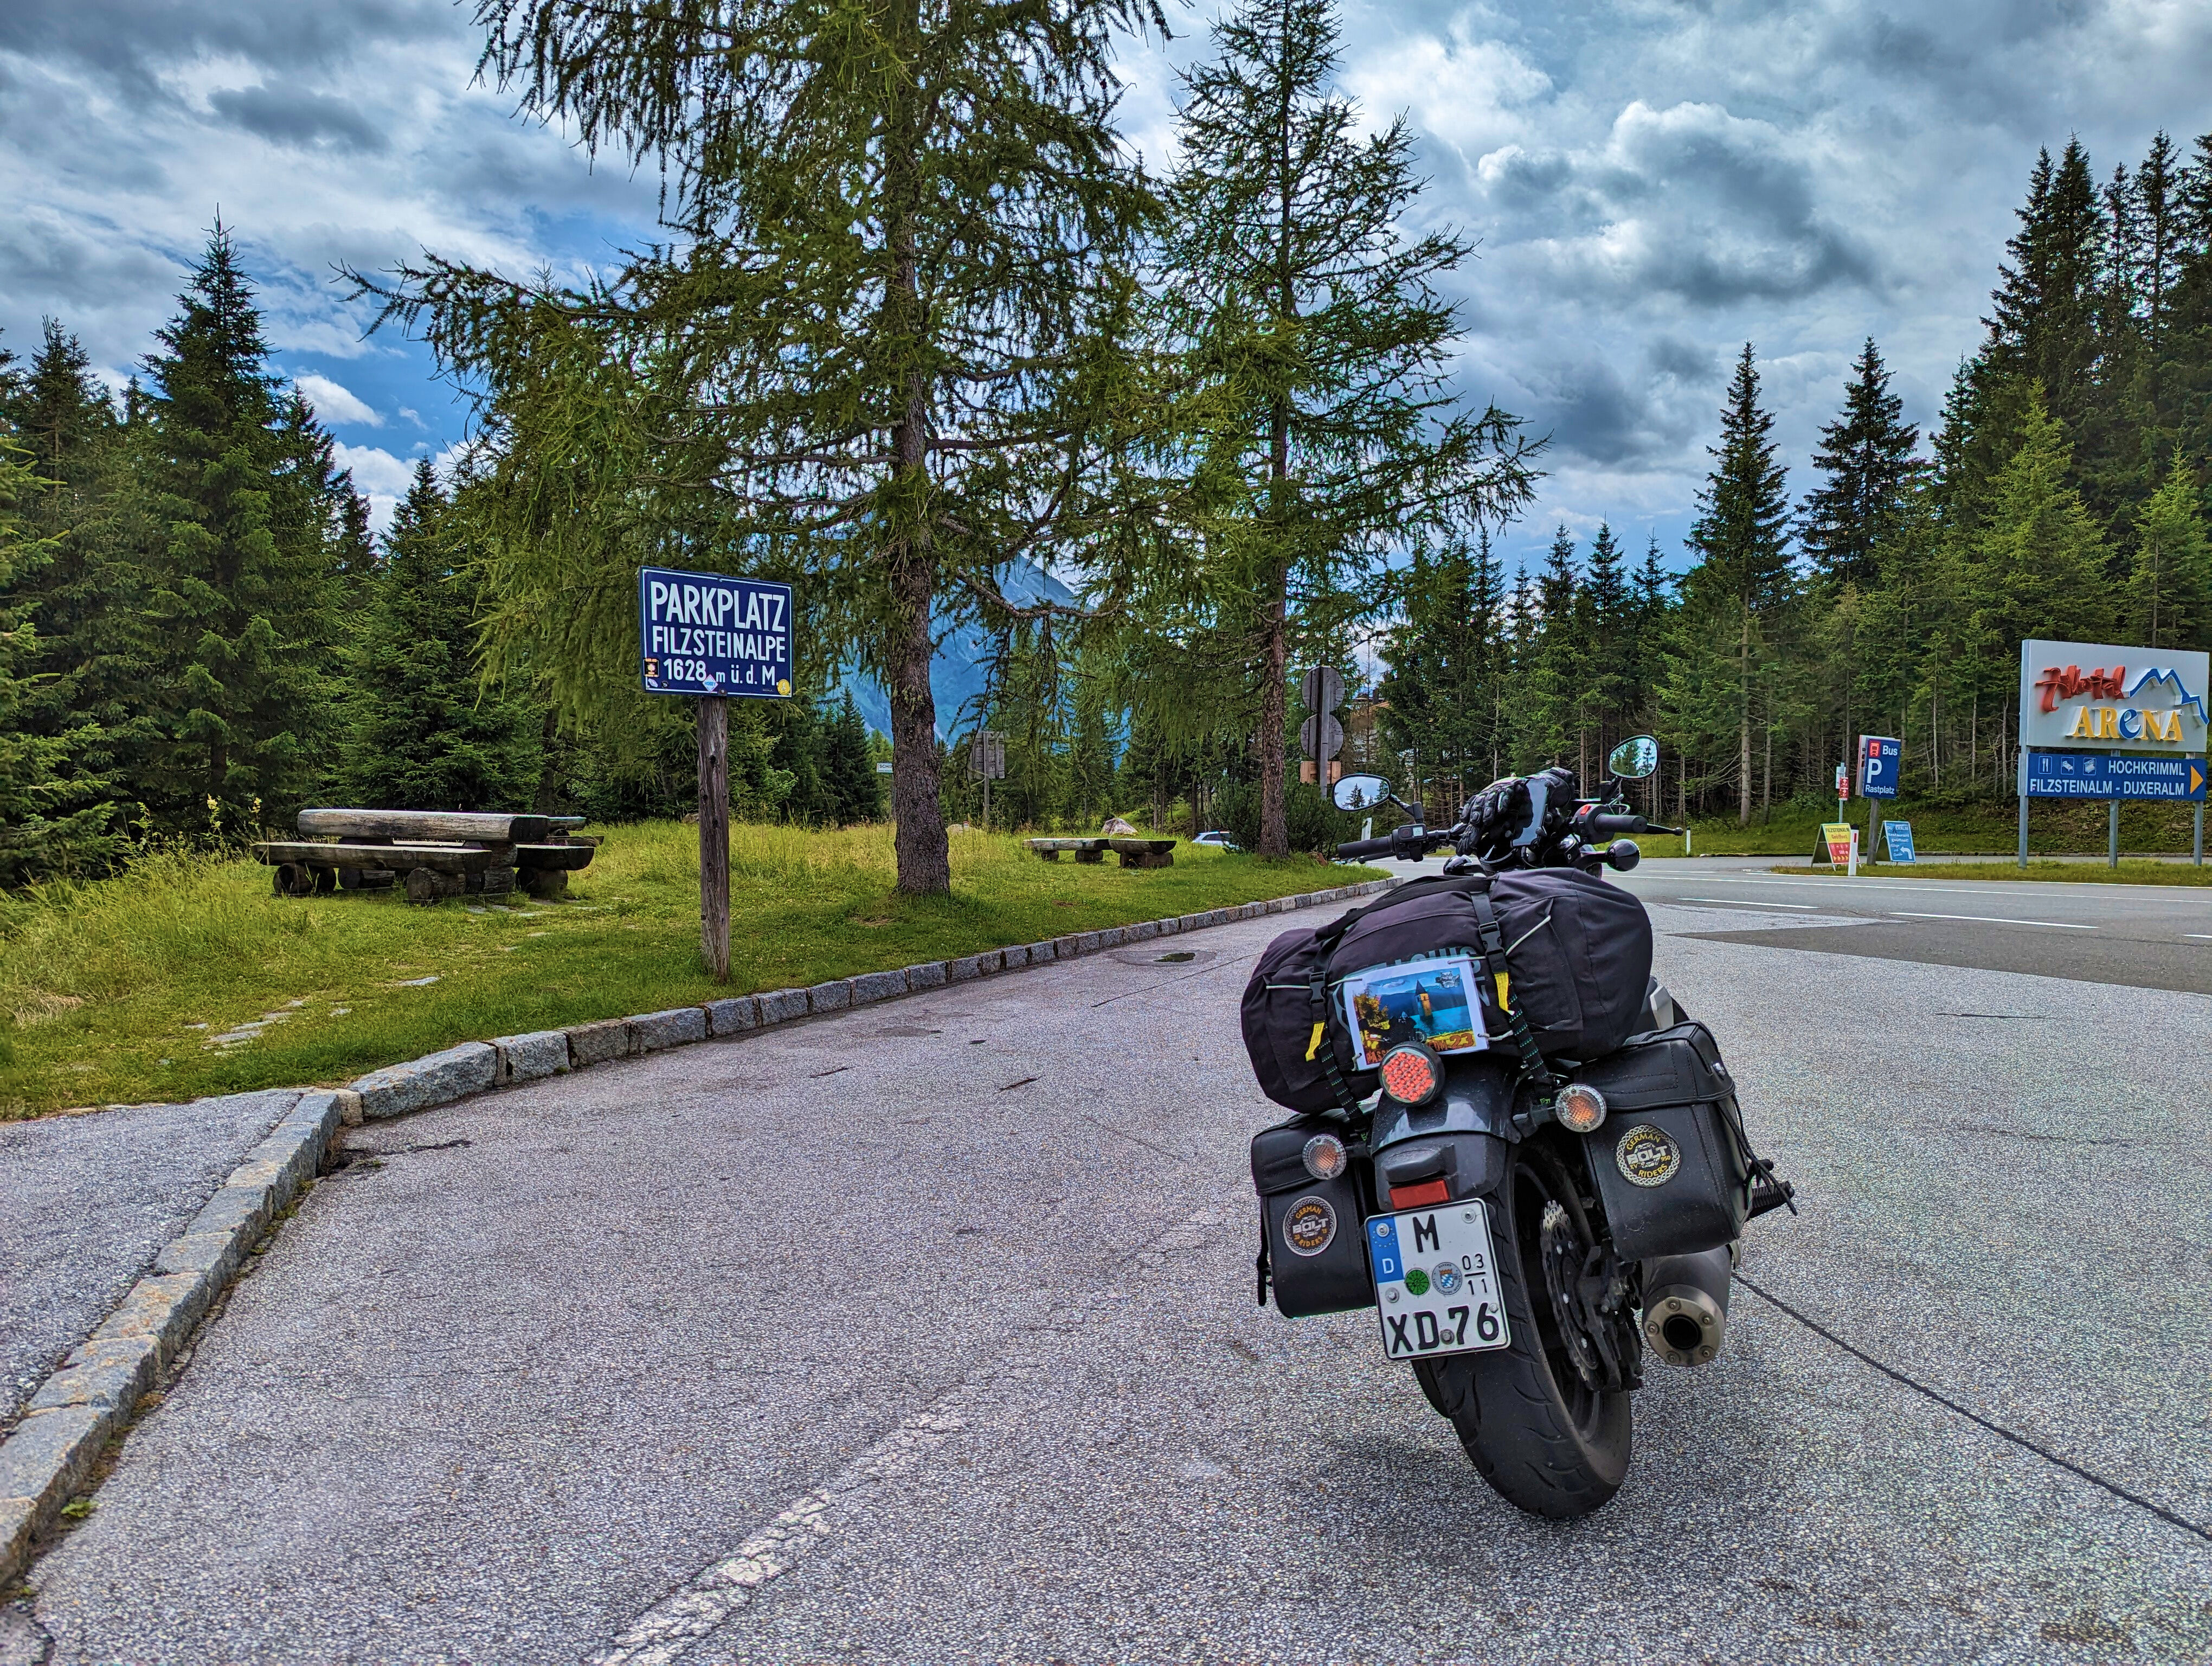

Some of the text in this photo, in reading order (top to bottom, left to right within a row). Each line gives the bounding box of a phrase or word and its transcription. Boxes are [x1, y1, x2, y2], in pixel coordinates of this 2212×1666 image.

[651, 581, 786, 632] PARKPLATZ
[652, 625, 786, 662] FILZSTEINALPE
[664, 658, 706, 682] 1628
[716, 671, 725, 683] m
[1882, 745, 1898, 756] Bus
[1867, 758, 1882, 784] P
[2108, 760, 2185, 776] HOCHKRIMML
[1865, 784, 1895, 795] Rastplatz
[2030, 778, 2112, 794] FILZSTEINALM
[2123, 781, 2184, 796] DUXERALM
[1450, 1033, 1474, 1048] 23
[1626, 1132, 1661, 1150] GERMAN
[1626, 1145, 1668, 1165] BOLT
[1638, 1163, 1668, 1178] RIDERS
[1295, 1205, 1322, 1219] GERMAN
[1292, 1218, 1329, 1234] BOLT
[1412, 1214, 1440, 1253] M
[1298, 1236, 1323, 1247] RIDERS
[1382, 1258, 1394, 1274] D
[1462, 1253, 1484, 1271] 03
[1467, 1278, 1488, 1295] 11
